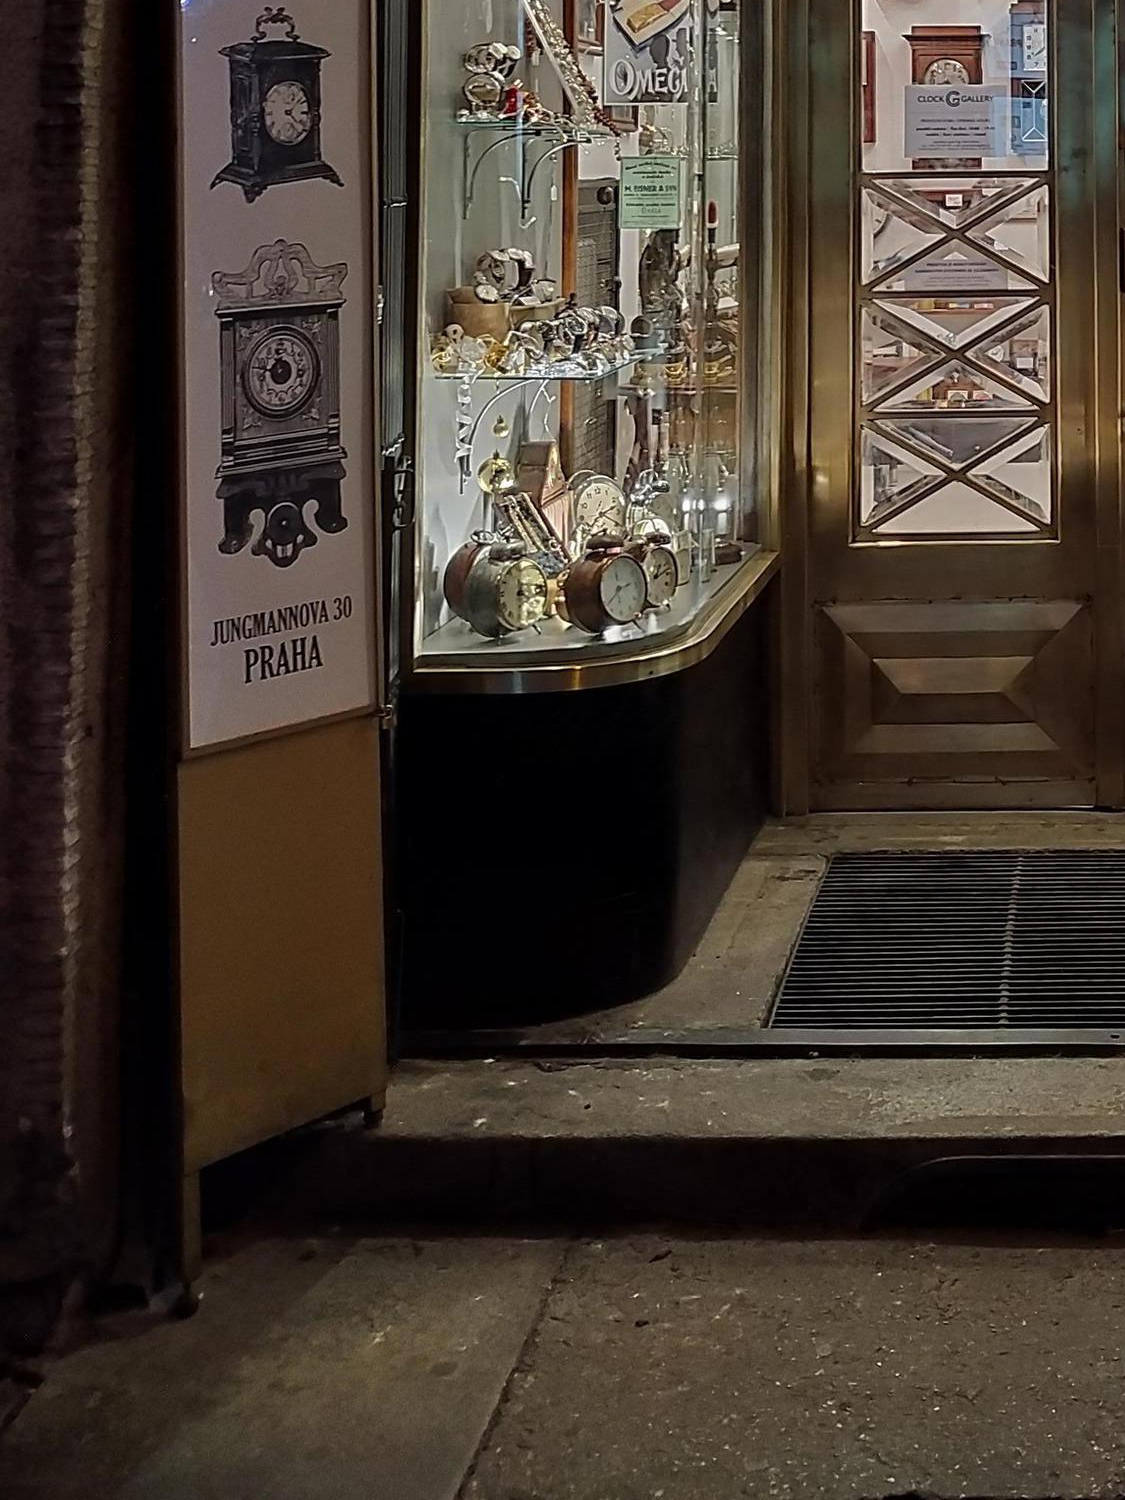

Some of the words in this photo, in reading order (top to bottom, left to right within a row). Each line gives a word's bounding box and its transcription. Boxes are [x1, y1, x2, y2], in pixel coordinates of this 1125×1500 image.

[961, 95, 993, 103] GALLERY
[210, 600, 330, 647] JUNGMANNOVA
[333, 595, 353, 621] 30
[244, 634, 325, 684] PRAHA
